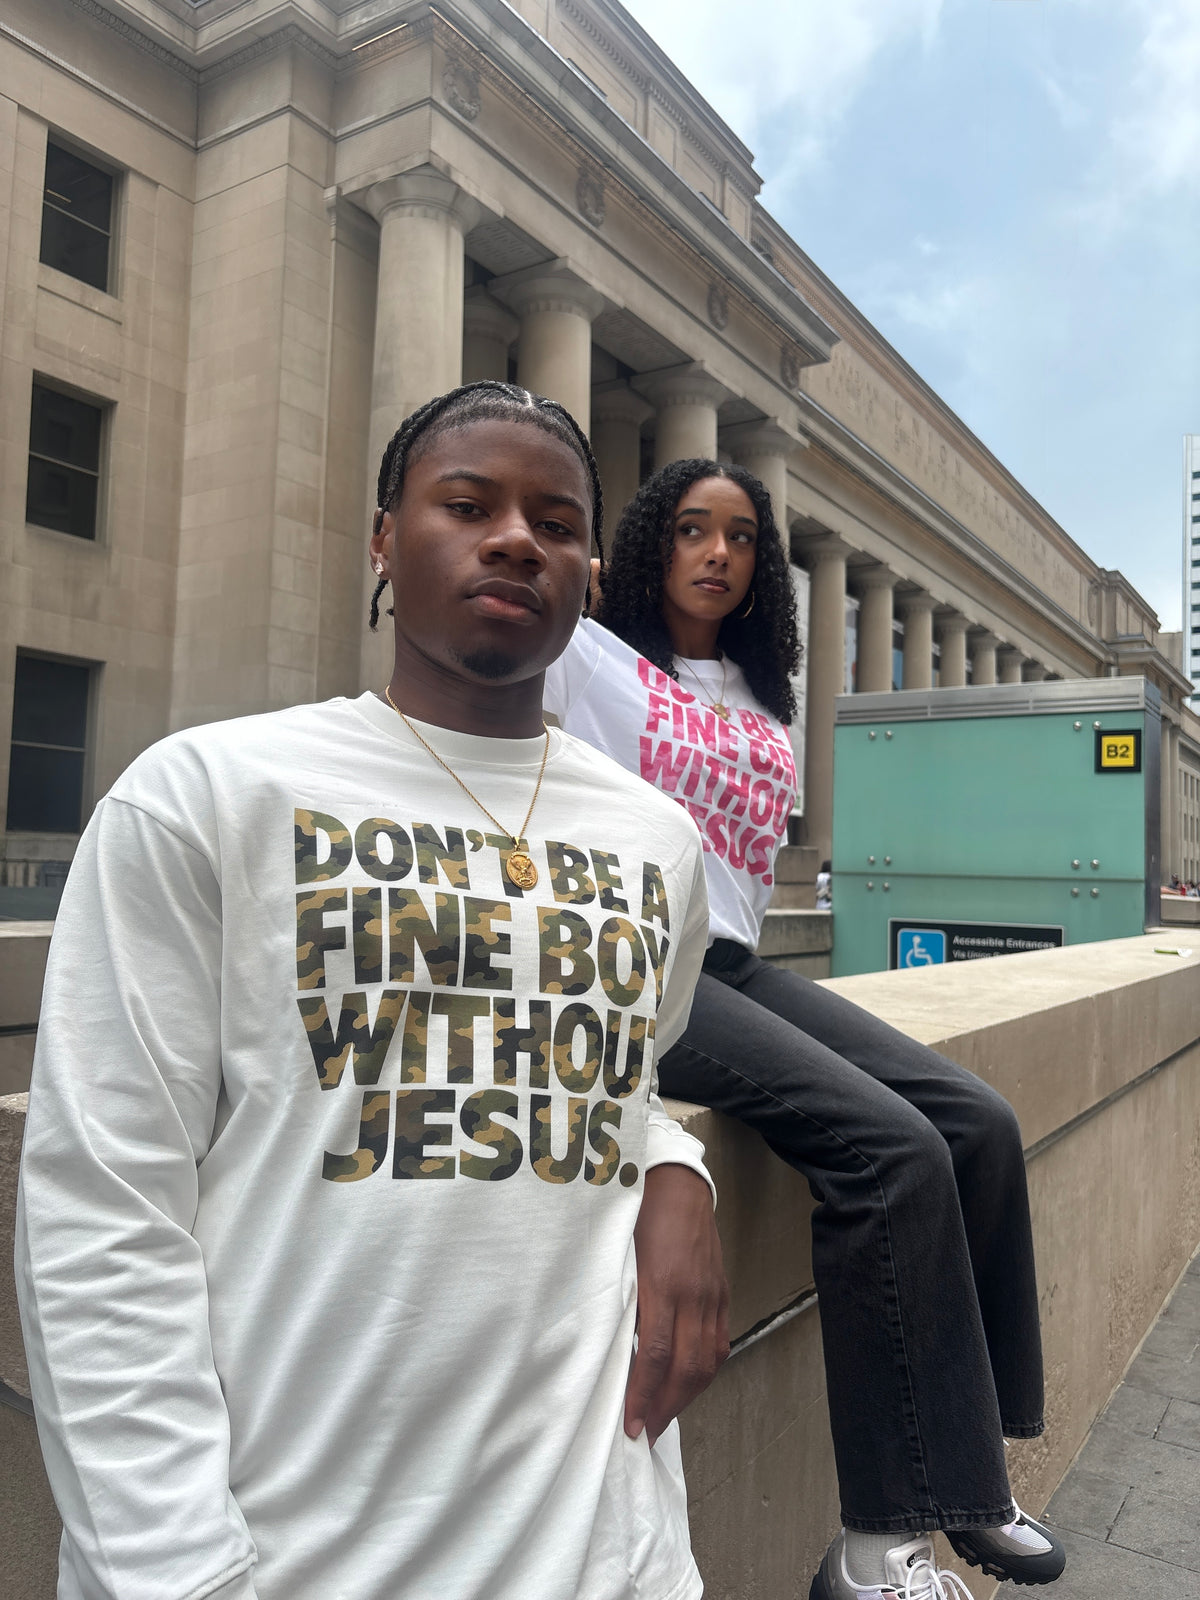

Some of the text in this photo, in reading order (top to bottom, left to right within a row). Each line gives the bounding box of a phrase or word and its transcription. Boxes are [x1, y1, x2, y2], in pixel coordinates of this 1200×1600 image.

[645, 691, 739, 763] FINE
[1106, 744, 1130, 758] B2
[639, 736, 795, 837] WITHOU
[544, 840, 630, 915] BE
[641, 861, 671, 934] A
[296, 887, 513, 991] FINE
[952, 935, 1056, 950] Accessible Entrances
[952, 950, 966, 959] Via
[322, 1089, 640, 1188] JESUS.
